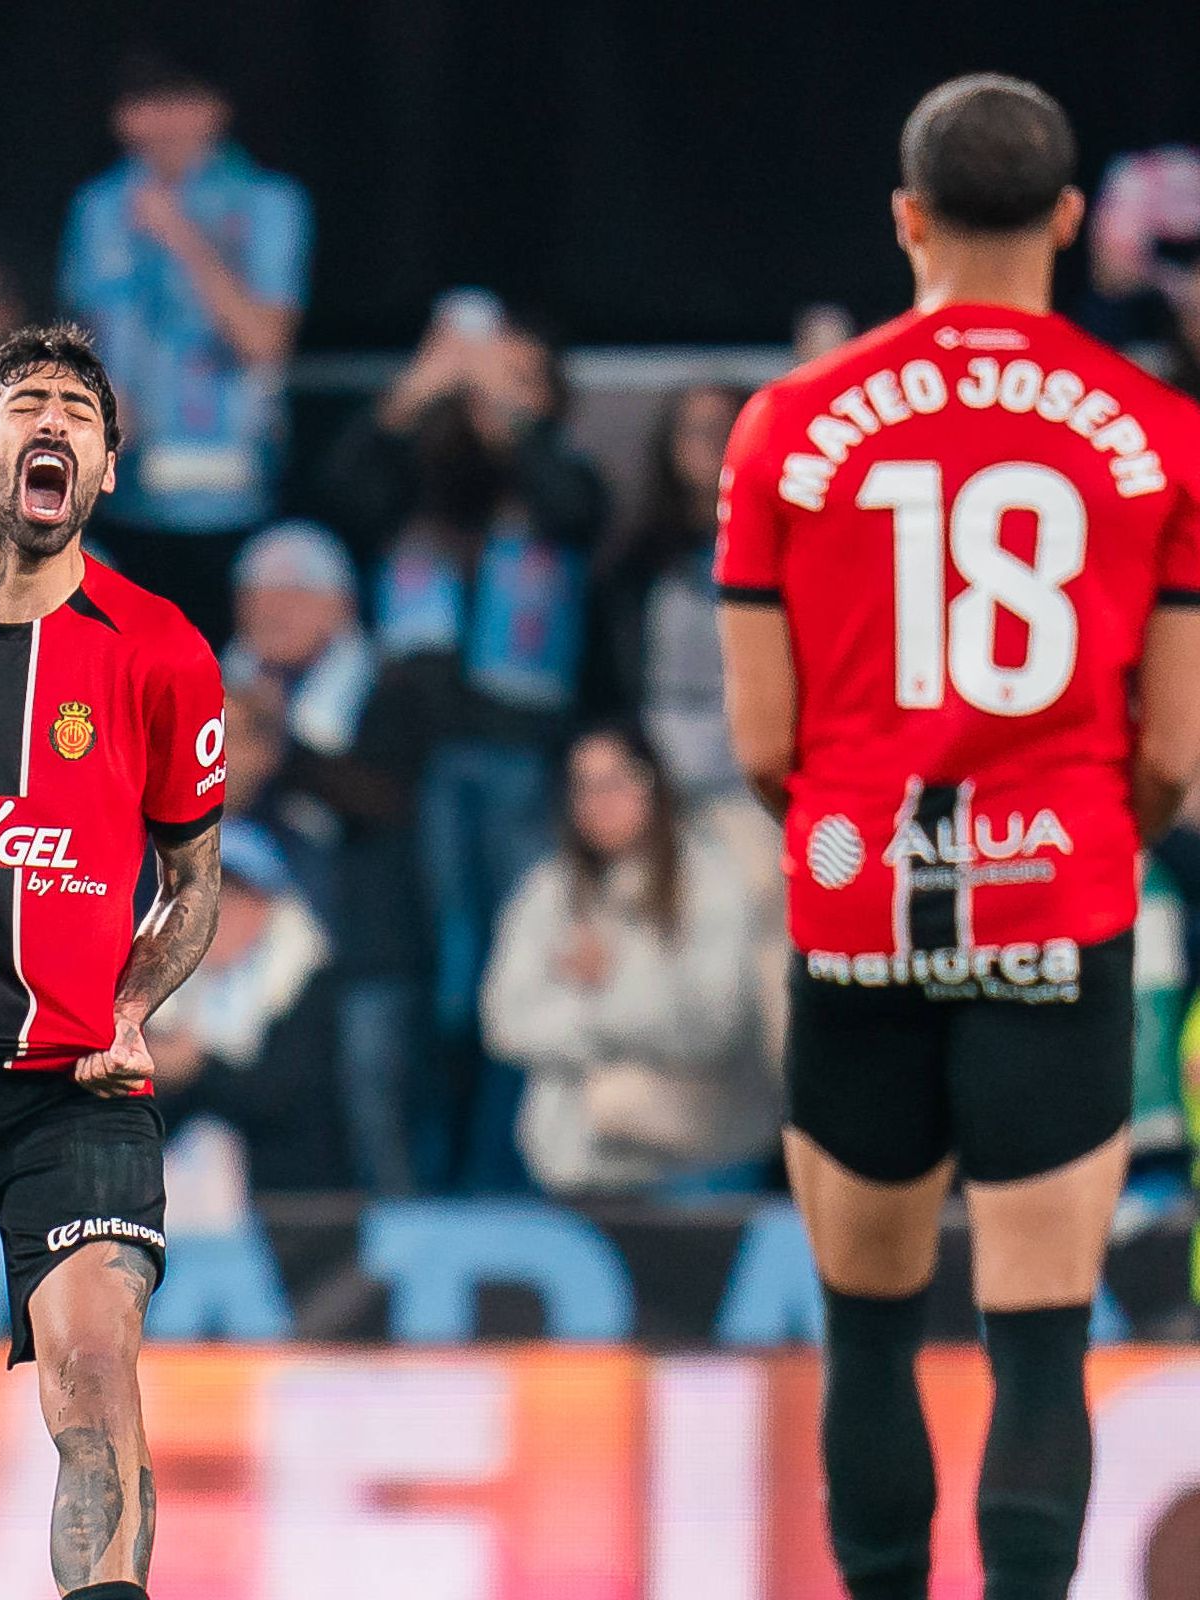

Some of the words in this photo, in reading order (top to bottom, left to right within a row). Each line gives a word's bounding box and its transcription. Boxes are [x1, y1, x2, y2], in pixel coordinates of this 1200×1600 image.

[779, 358, 949, 512] MATEO
[956, 356, 1166, 499] JOSEPH
[854, 459, 1089, 718] 18
[882, 809, 1074, 867] ALUA
[27, 871, 54, 896] by
[59, 874, 108, 896] Taica
[82, 1217, 167, 1249] AirEuropa
